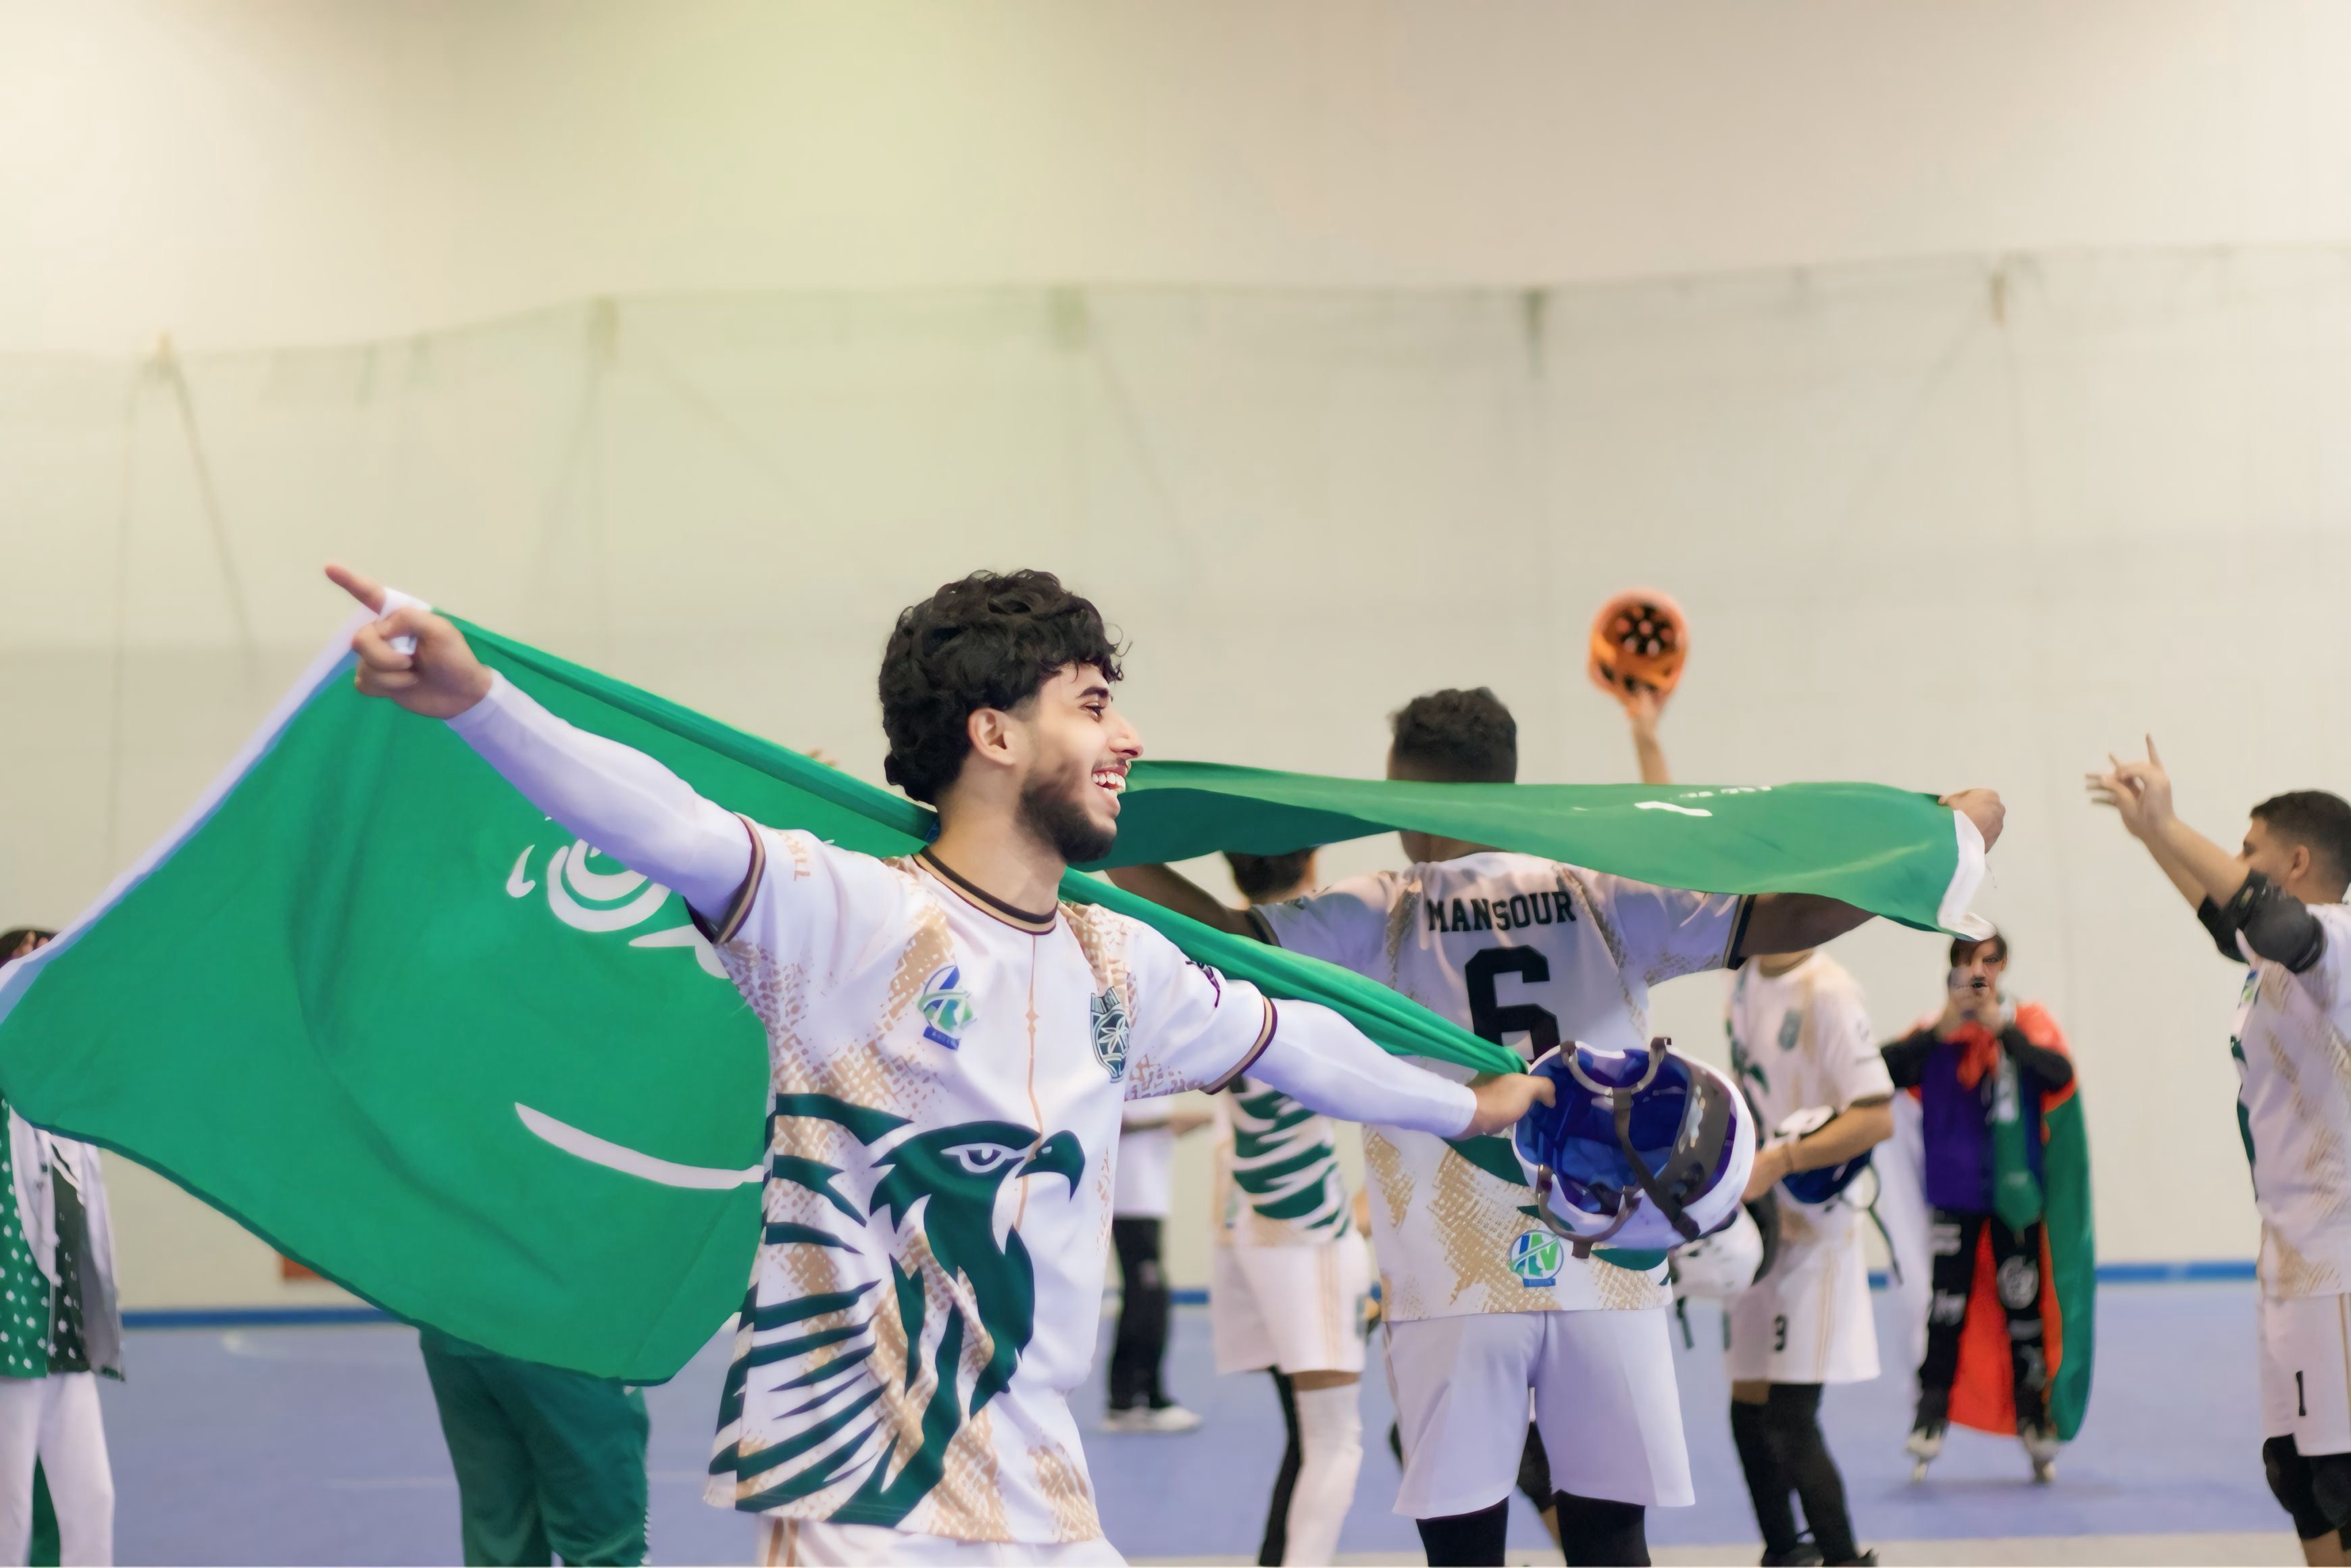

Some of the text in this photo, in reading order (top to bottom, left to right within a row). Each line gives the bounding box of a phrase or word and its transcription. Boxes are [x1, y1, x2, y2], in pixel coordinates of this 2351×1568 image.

[1427, 891, 1577, 932] MANSOUR
[1465, 944, 1561, 1065] 6
[2295, 1370, 2307, 1417] 1
